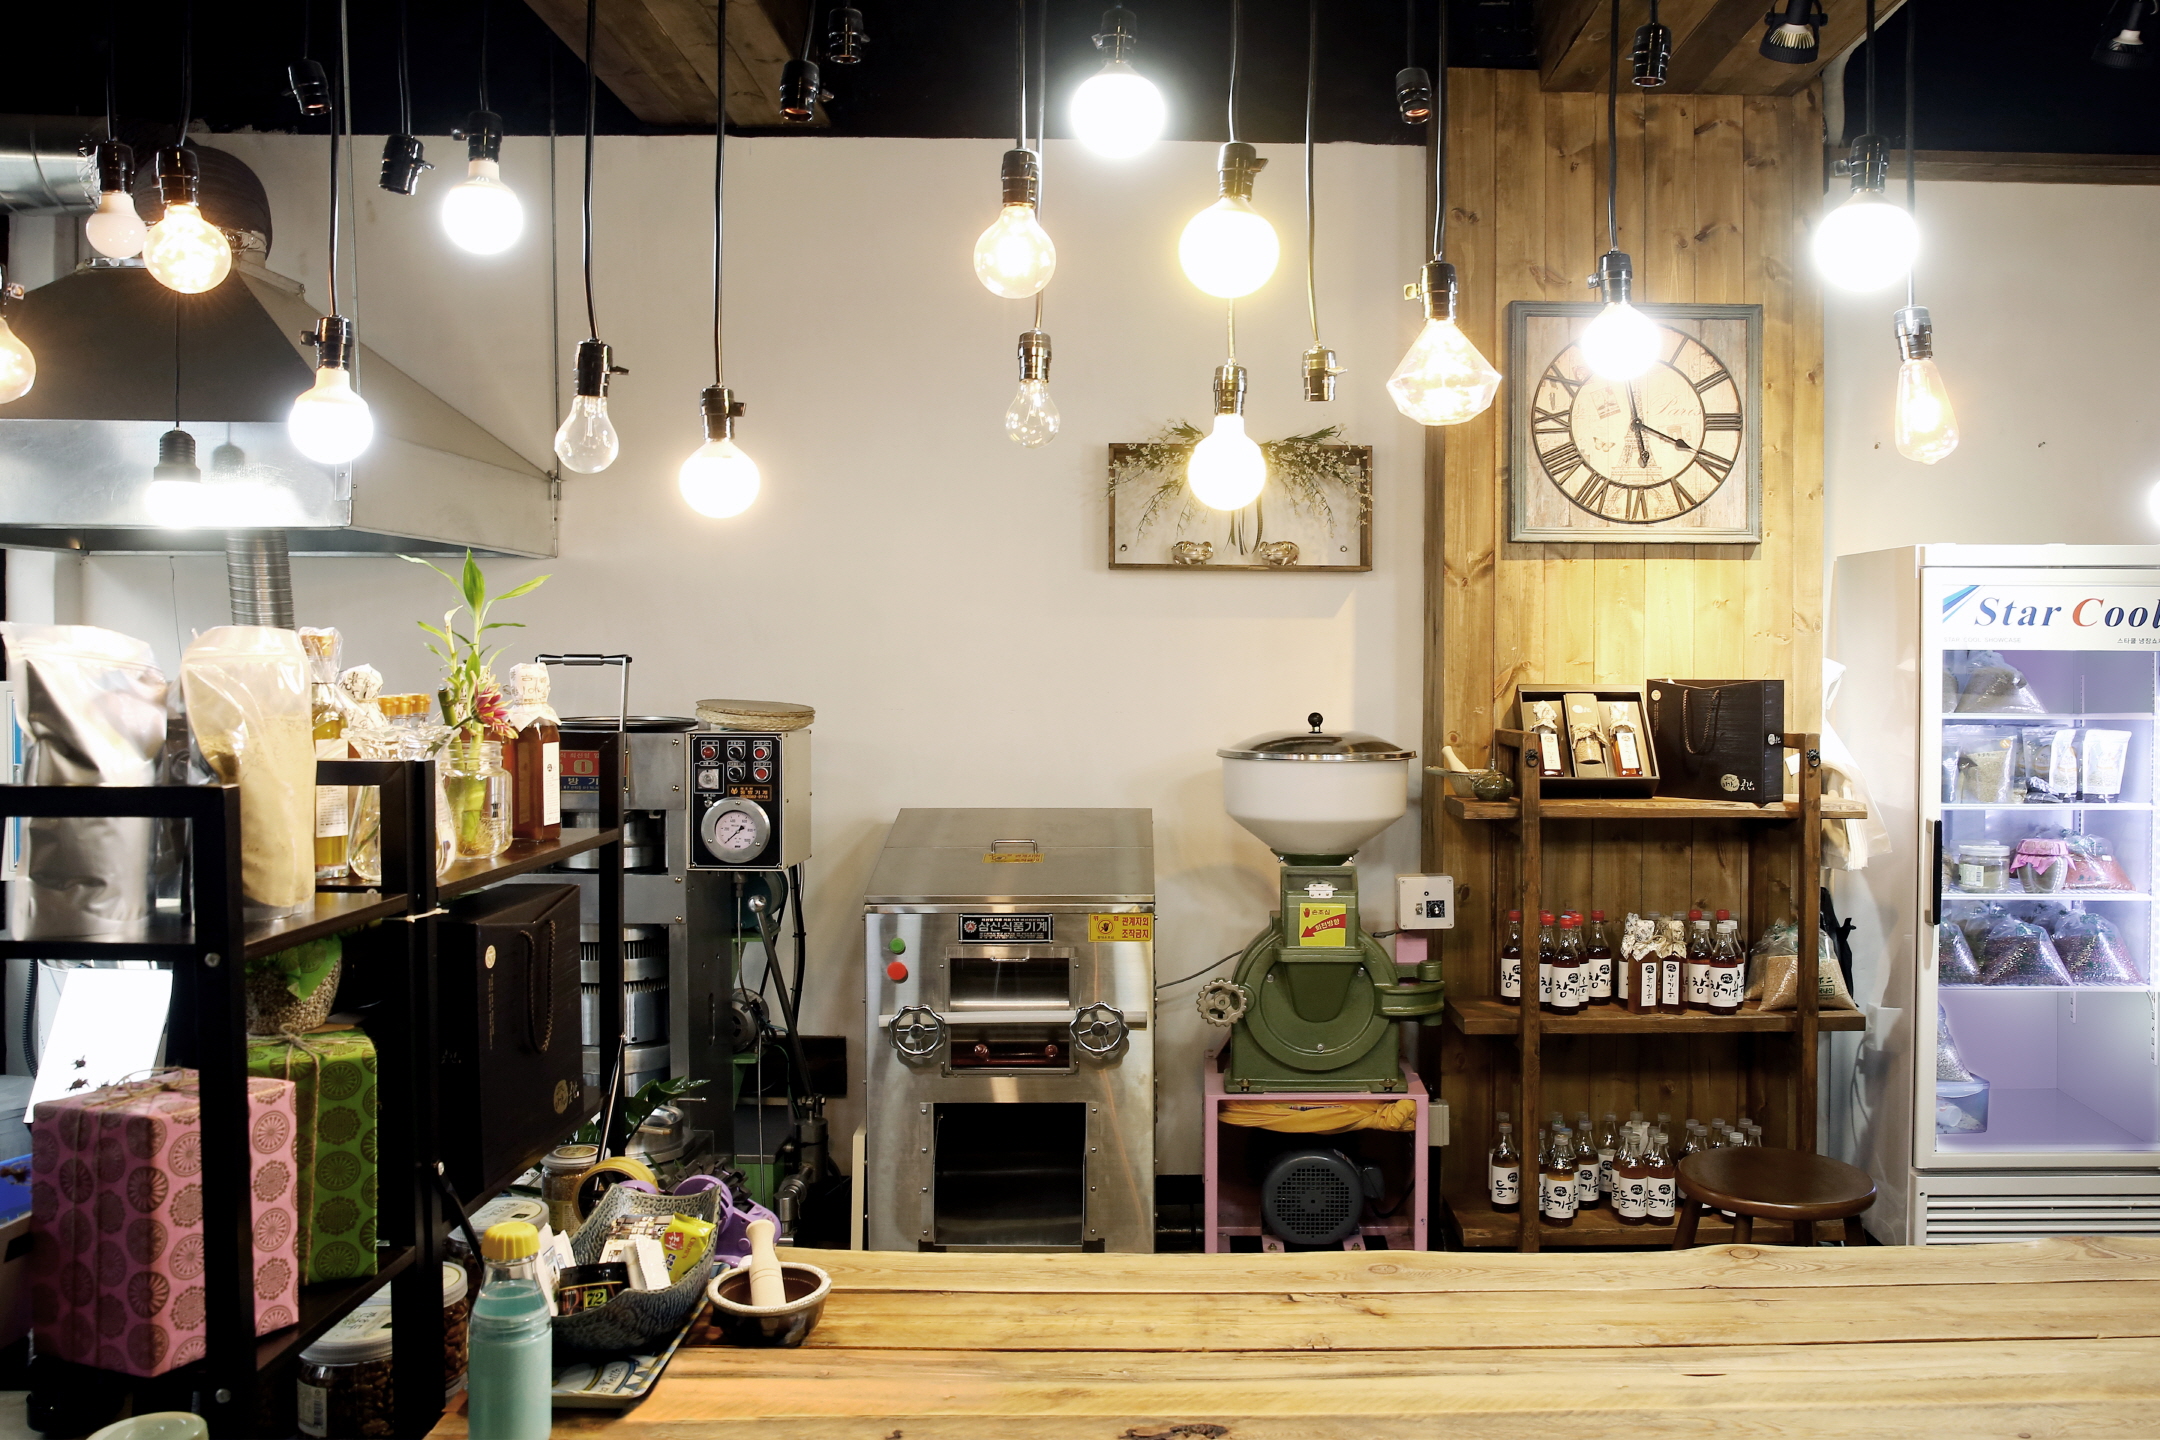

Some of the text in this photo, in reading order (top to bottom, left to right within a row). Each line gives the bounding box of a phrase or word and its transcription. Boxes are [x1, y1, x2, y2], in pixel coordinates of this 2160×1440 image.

[1650, 393, 1702, 417] Paris
[1974, 596, 2062, 627] Star
[1984, 636, 2022, 644] SHOWCASE
[2116, 637, 2137, 645] 스타쿨
[978, 921, 1048, 932] 삼신식품기계
[1121, 916, 1149, 926] 관계자외
[1121, 928, 1149, 939] 조작금지
[586, 1291, 605, 1306] 72
